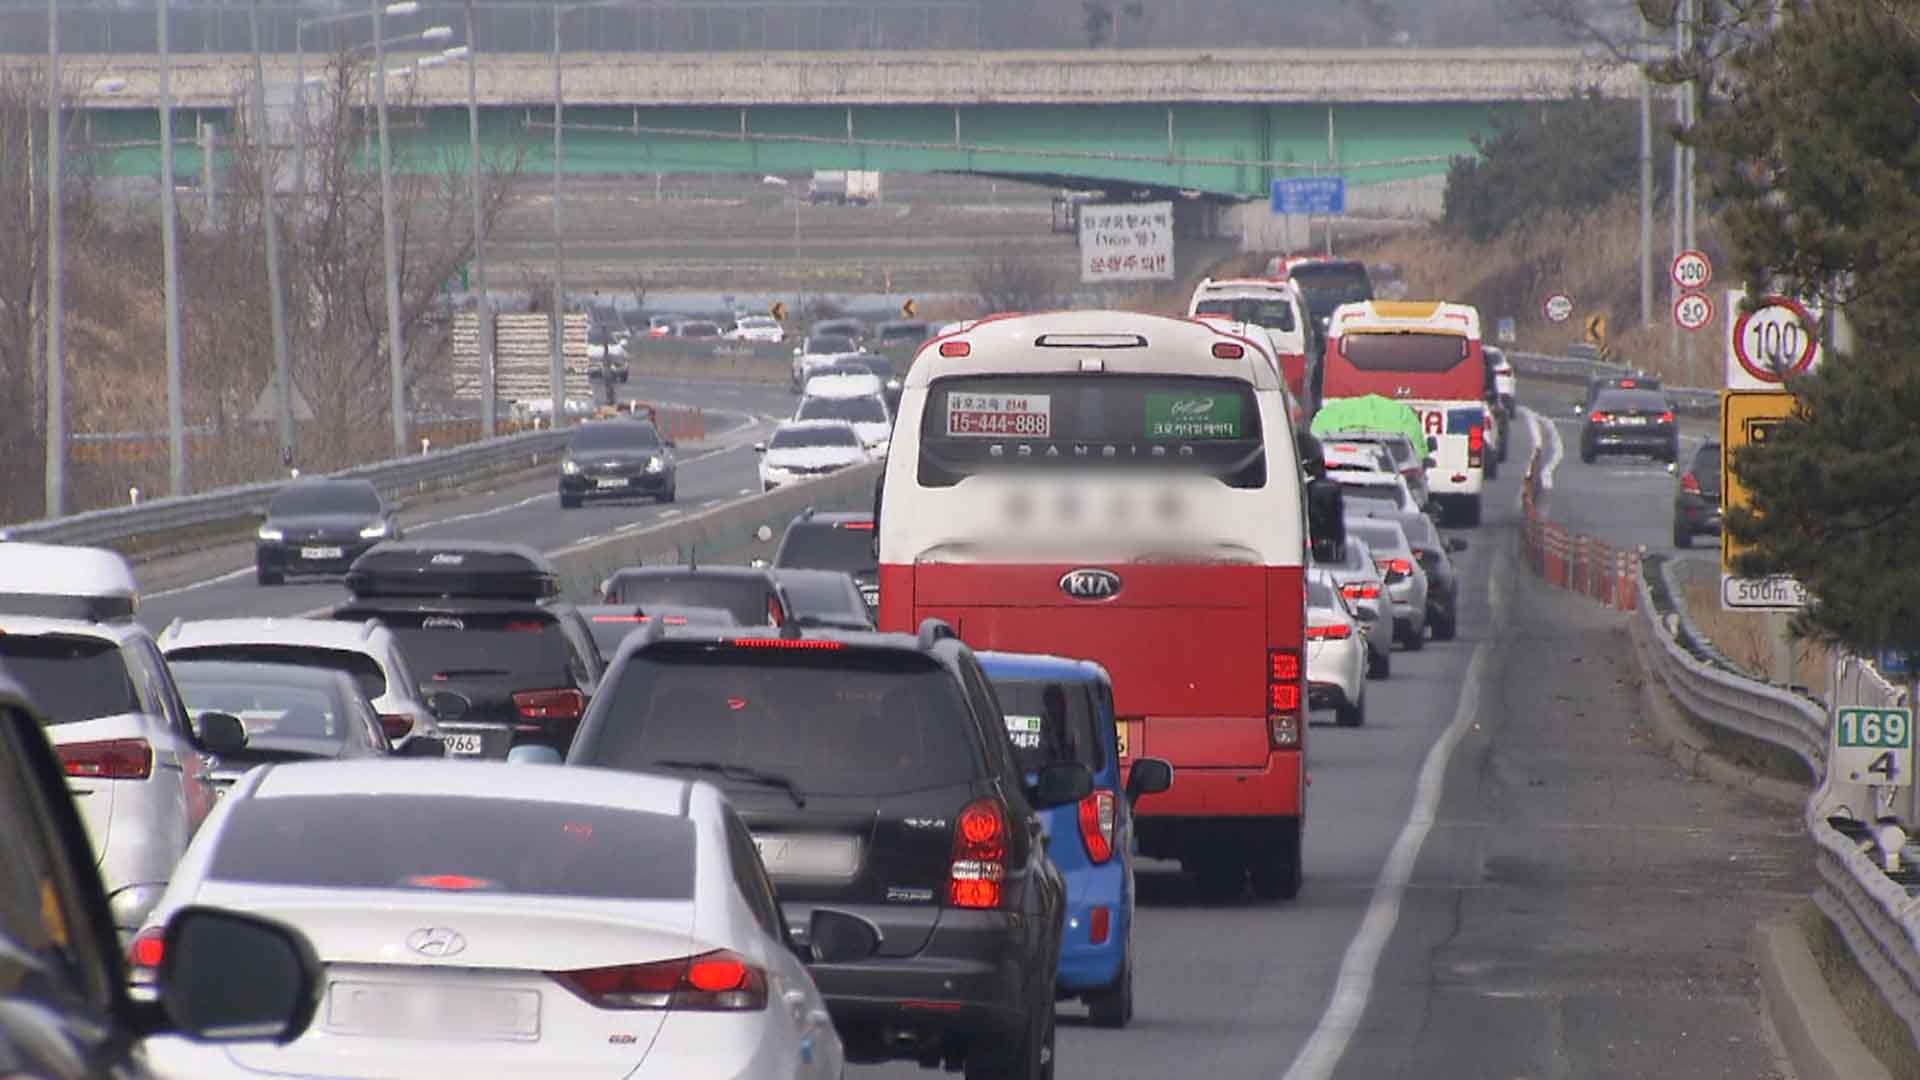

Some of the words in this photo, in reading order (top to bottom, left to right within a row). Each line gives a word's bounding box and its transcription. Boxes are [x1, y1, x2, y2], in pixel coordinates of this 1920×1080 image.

[1679, 263, 1704, 280] 100
[1753, 322, 1797, 360] 100
[951, 413, 1046, 433] 15-444-888
[1070, 575, 1112, 594] KIA
[1738, 583, 1787, 600] 500m
[1841, 710, 1906, 746] 169
